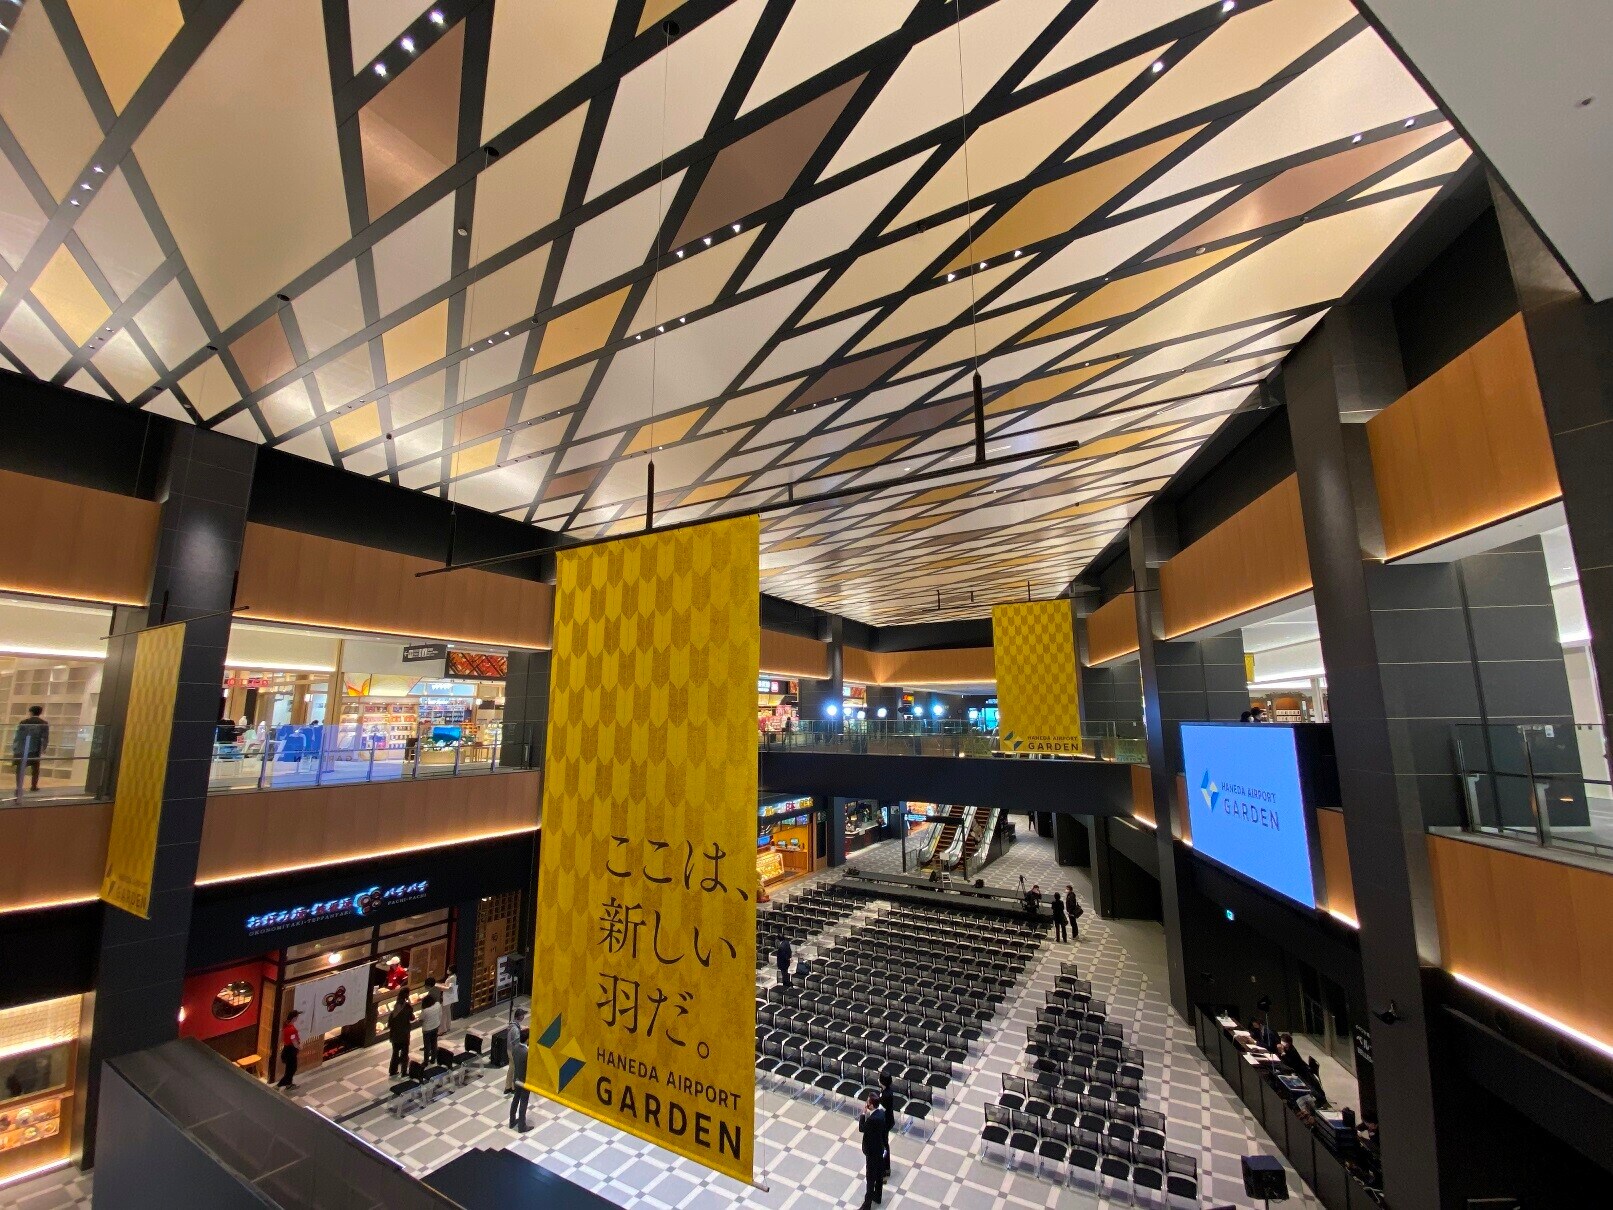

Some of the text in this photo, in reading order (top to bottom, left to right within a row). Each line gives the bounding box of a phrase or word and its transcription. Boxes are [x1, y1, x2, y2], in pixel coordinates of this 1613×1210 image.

[1028, 742, 1079, 751] GARDEN
[1221, 782, 1277, 804] HANEDA AIRPORT
[1223, 798, 1280, 832] GARDEN
[605, 835, 749, 901] ここは、
[596, 897, 737, 967] 新しい
[596, 972, 711, 1060] 羽だ。
[596, 1046, 741, 1111] HANEDA AIRPORT
[596, 1076, 742, 1161] GARDEN
